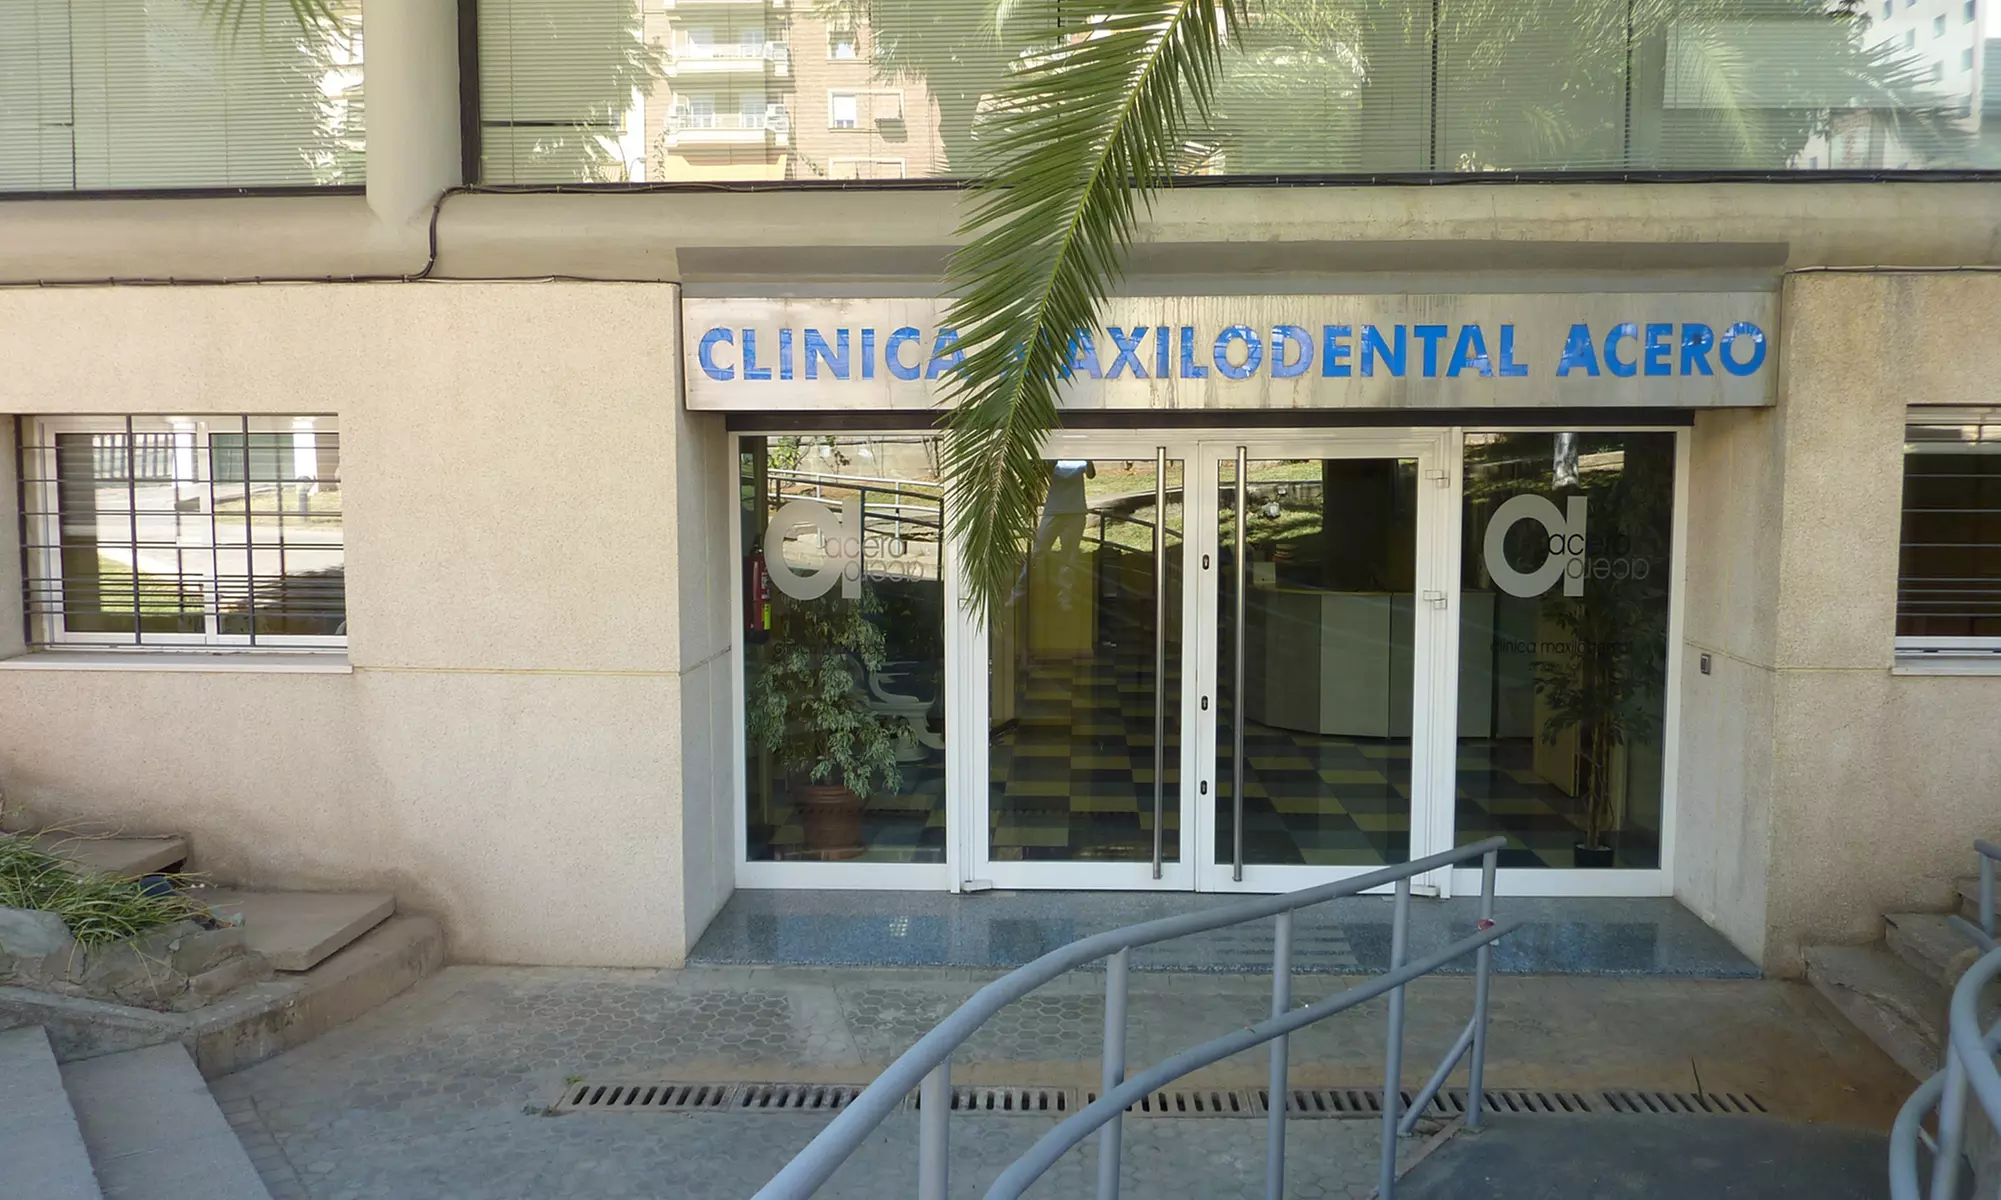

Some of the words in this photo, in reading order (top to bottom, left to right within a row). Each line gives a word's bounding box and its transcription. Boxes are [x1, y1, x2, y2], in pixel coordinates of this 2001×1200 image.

[699, 326, 973, 381] CLINICA
[997, 325, 1528, 380] AXILODENTAL
[1556, 322, 1767, 377] ACERO
[823, 536, 906, 559] acero
[1548, 533, 1631, 556] acero
